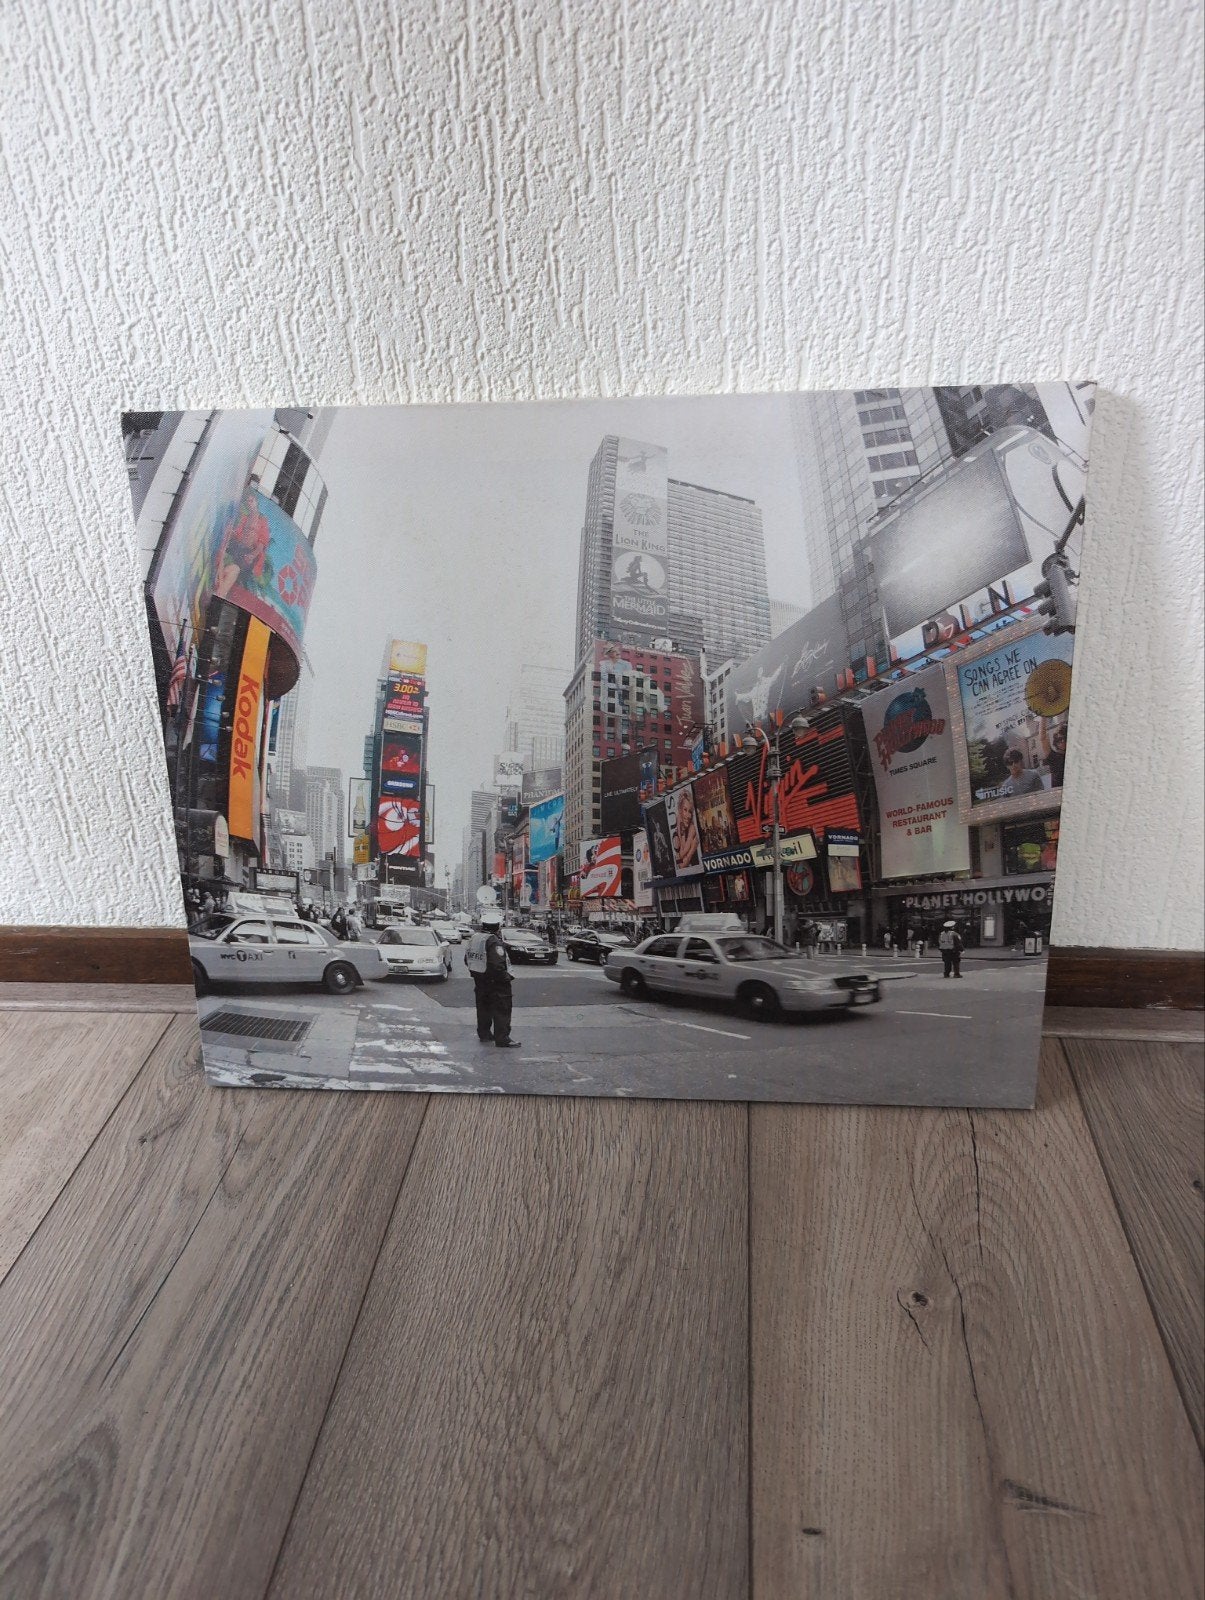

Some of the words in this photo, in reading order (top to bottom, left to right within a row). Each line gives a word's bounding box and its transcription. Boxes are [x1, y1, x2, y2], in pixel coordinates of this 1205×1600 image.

[963, 657, 1001, 687] SONGS
[1004, 648, 1022, 666] WE
[971, 678, 990, 697] CAN
[991, 663, 1022, 688] AGREE
[1023, 656, 1038, 675] ON
[232, 674, 260, 780] Kodak
[909, 756, 938, 770] SQUARE
[885, 797, 954, 819] WORLD-FAMOUS
[892, 810, 947, 829] RESTAURANT
[914, 825, 932, 836] BAR
[703, 852, 752, 872] VORNADO
[905, 893, 959, 910] PLANET
